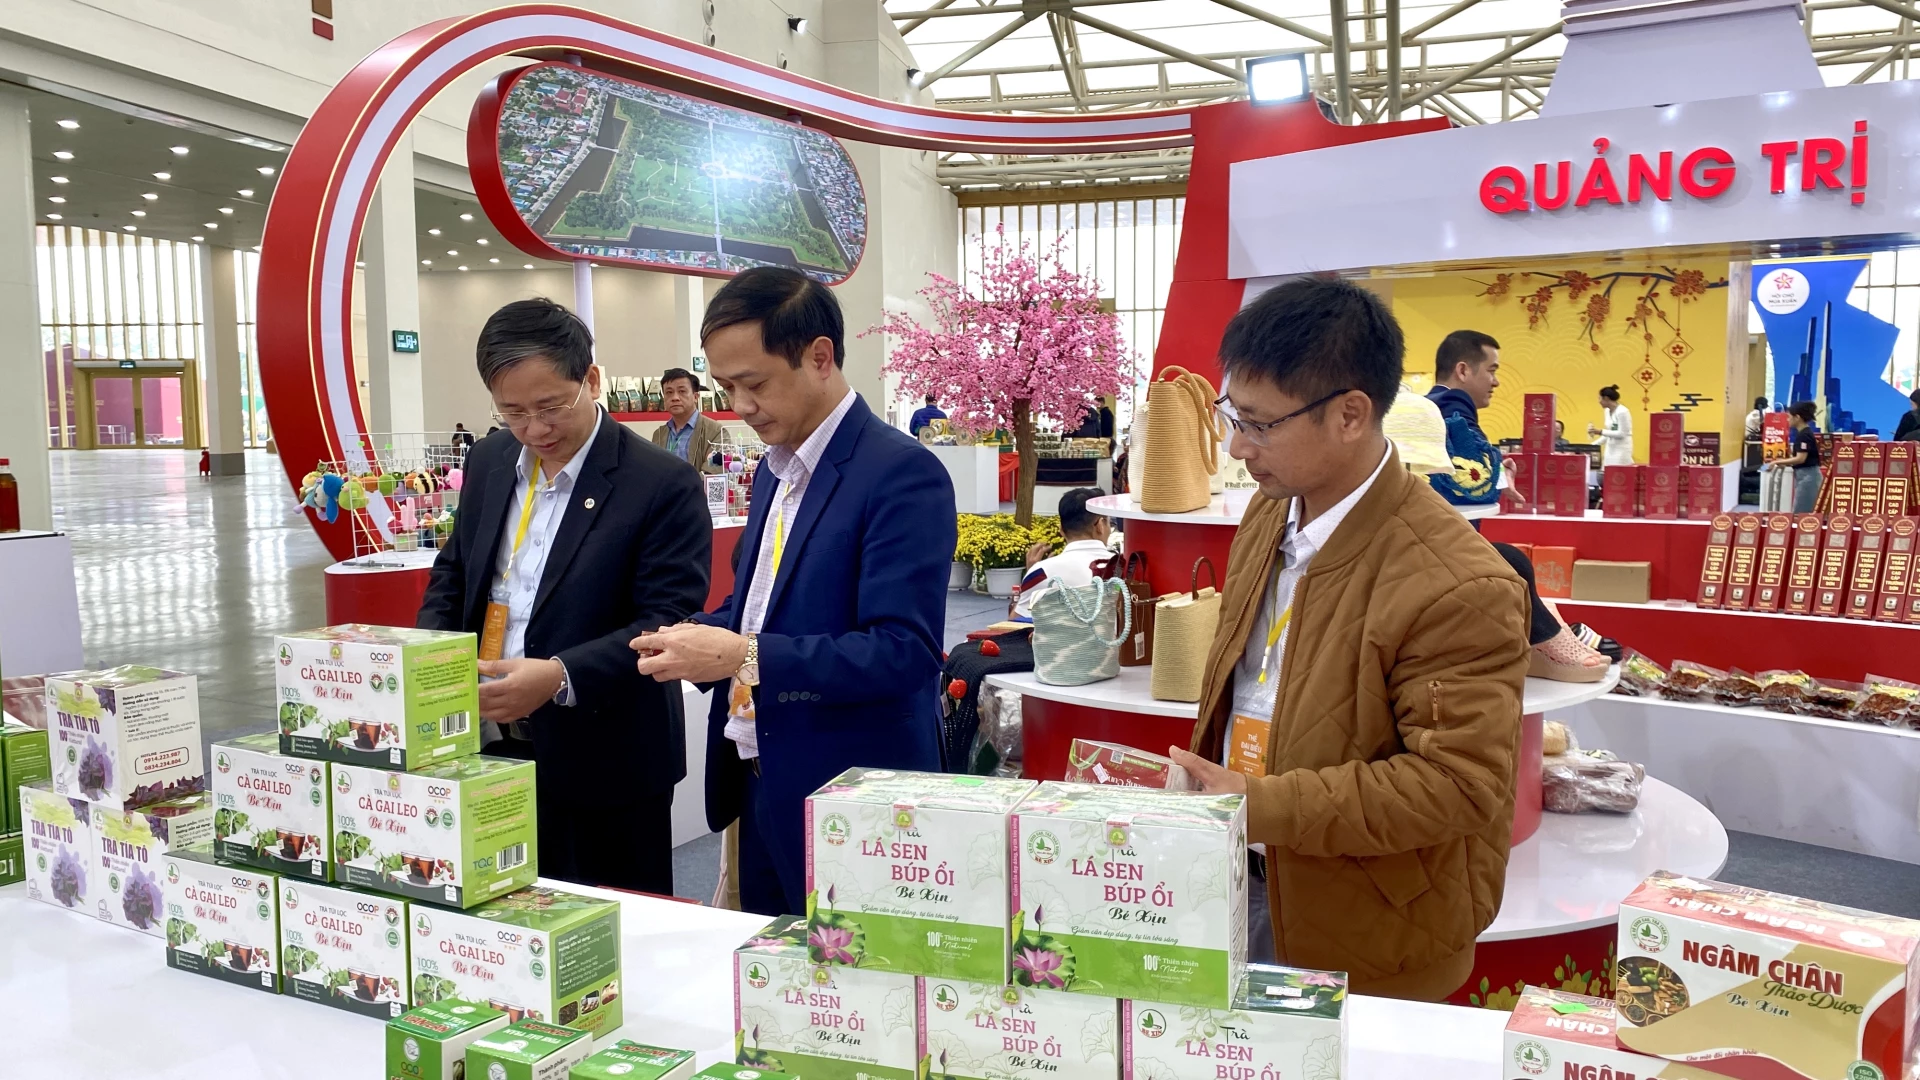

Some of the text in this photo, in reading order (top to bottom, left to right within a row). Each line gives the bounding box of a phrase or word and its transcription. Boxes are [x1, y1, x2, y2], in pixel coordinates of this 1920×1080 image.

[1479, 119, 1869, 214] QUẢNG TRỊ
[370, 652, 393, 661] OCOP
[301, 665, 362, 684] CÀ GAI LEO
[281, 686, 300, 697] 100%
[416, 722, 436, 734] TQC
[285, 763, 305, 773] OCOP
[237, 774, 292, 796] CÀ GAI LEO
[428, 785, 451, 796] OCOP
[217, 793, 235, 804] 100%
[359, 794, 418, 818] CÀ GAI LEO
[337, 815, 356, 827] 100%
[136, 844, 148, 864] TÔ
[862, 837, 927, 861] LÁ SEN
[472, 856, 493, 870] TQC
[1072, 855, 1144, 881] LÁ SEN
[232, 877, 251, 887] OCOP
[891, 861, 955, 886] BÚP ỔI
[185, 885, 237, 909] CÀ GAI LEO
[896, 885, 951, 904] Bé Xịn
[1104, 881, 1174, 907] BÚP ỔI
[168, 903, 184, 915] 100%
[357, 902, 379, 913] OCOP
[1108, 906, 1168, 925] Bé Xịn
[1668, 895, 1826, 935] NGÂM CHÂN
[305, 911, 362, 936] CÀ GAI LEO
[285, 929, 303, 942] 100%
[497, 930, 522, 943] OCOP
[926, 931, 944, 947] 100%
[944, 934, 960, 942] Thiên
[440, 939, 505, 965] CÀ GAI LEO
[1162, 957, 1180, 965] Thiên
[417, 957, 438, 970] 100%
[1143, 954, 1162, 971] 100%
[1683, 939, 1844, 997] NGÂM CHÂN
[784, 988, 841, 1009] LÁ SEN
[1726, 992, 1790, 1017] Bé Xịn
[1763, 980, 1864, 1015] Thảo Dược
[810, 1011, 865, 1032] BÚP ỔI
[975, 1011, 1036, 1035] LÁ SEN
[1546, 1016, 1609, 1035] CHÂN
[816, 1029, 862, 1046] Bé Xịn
[1219, 1025, 1250, 1044] Trà
[1002, 1035, 1062, 1057] BÚP ỔI
[1186, 1037, 1253, 1062] LÁ SEN
[1008, 1055, 1058, 1072] Bé Xịn
[1216, 1062, 1255, 1080] BÚP
